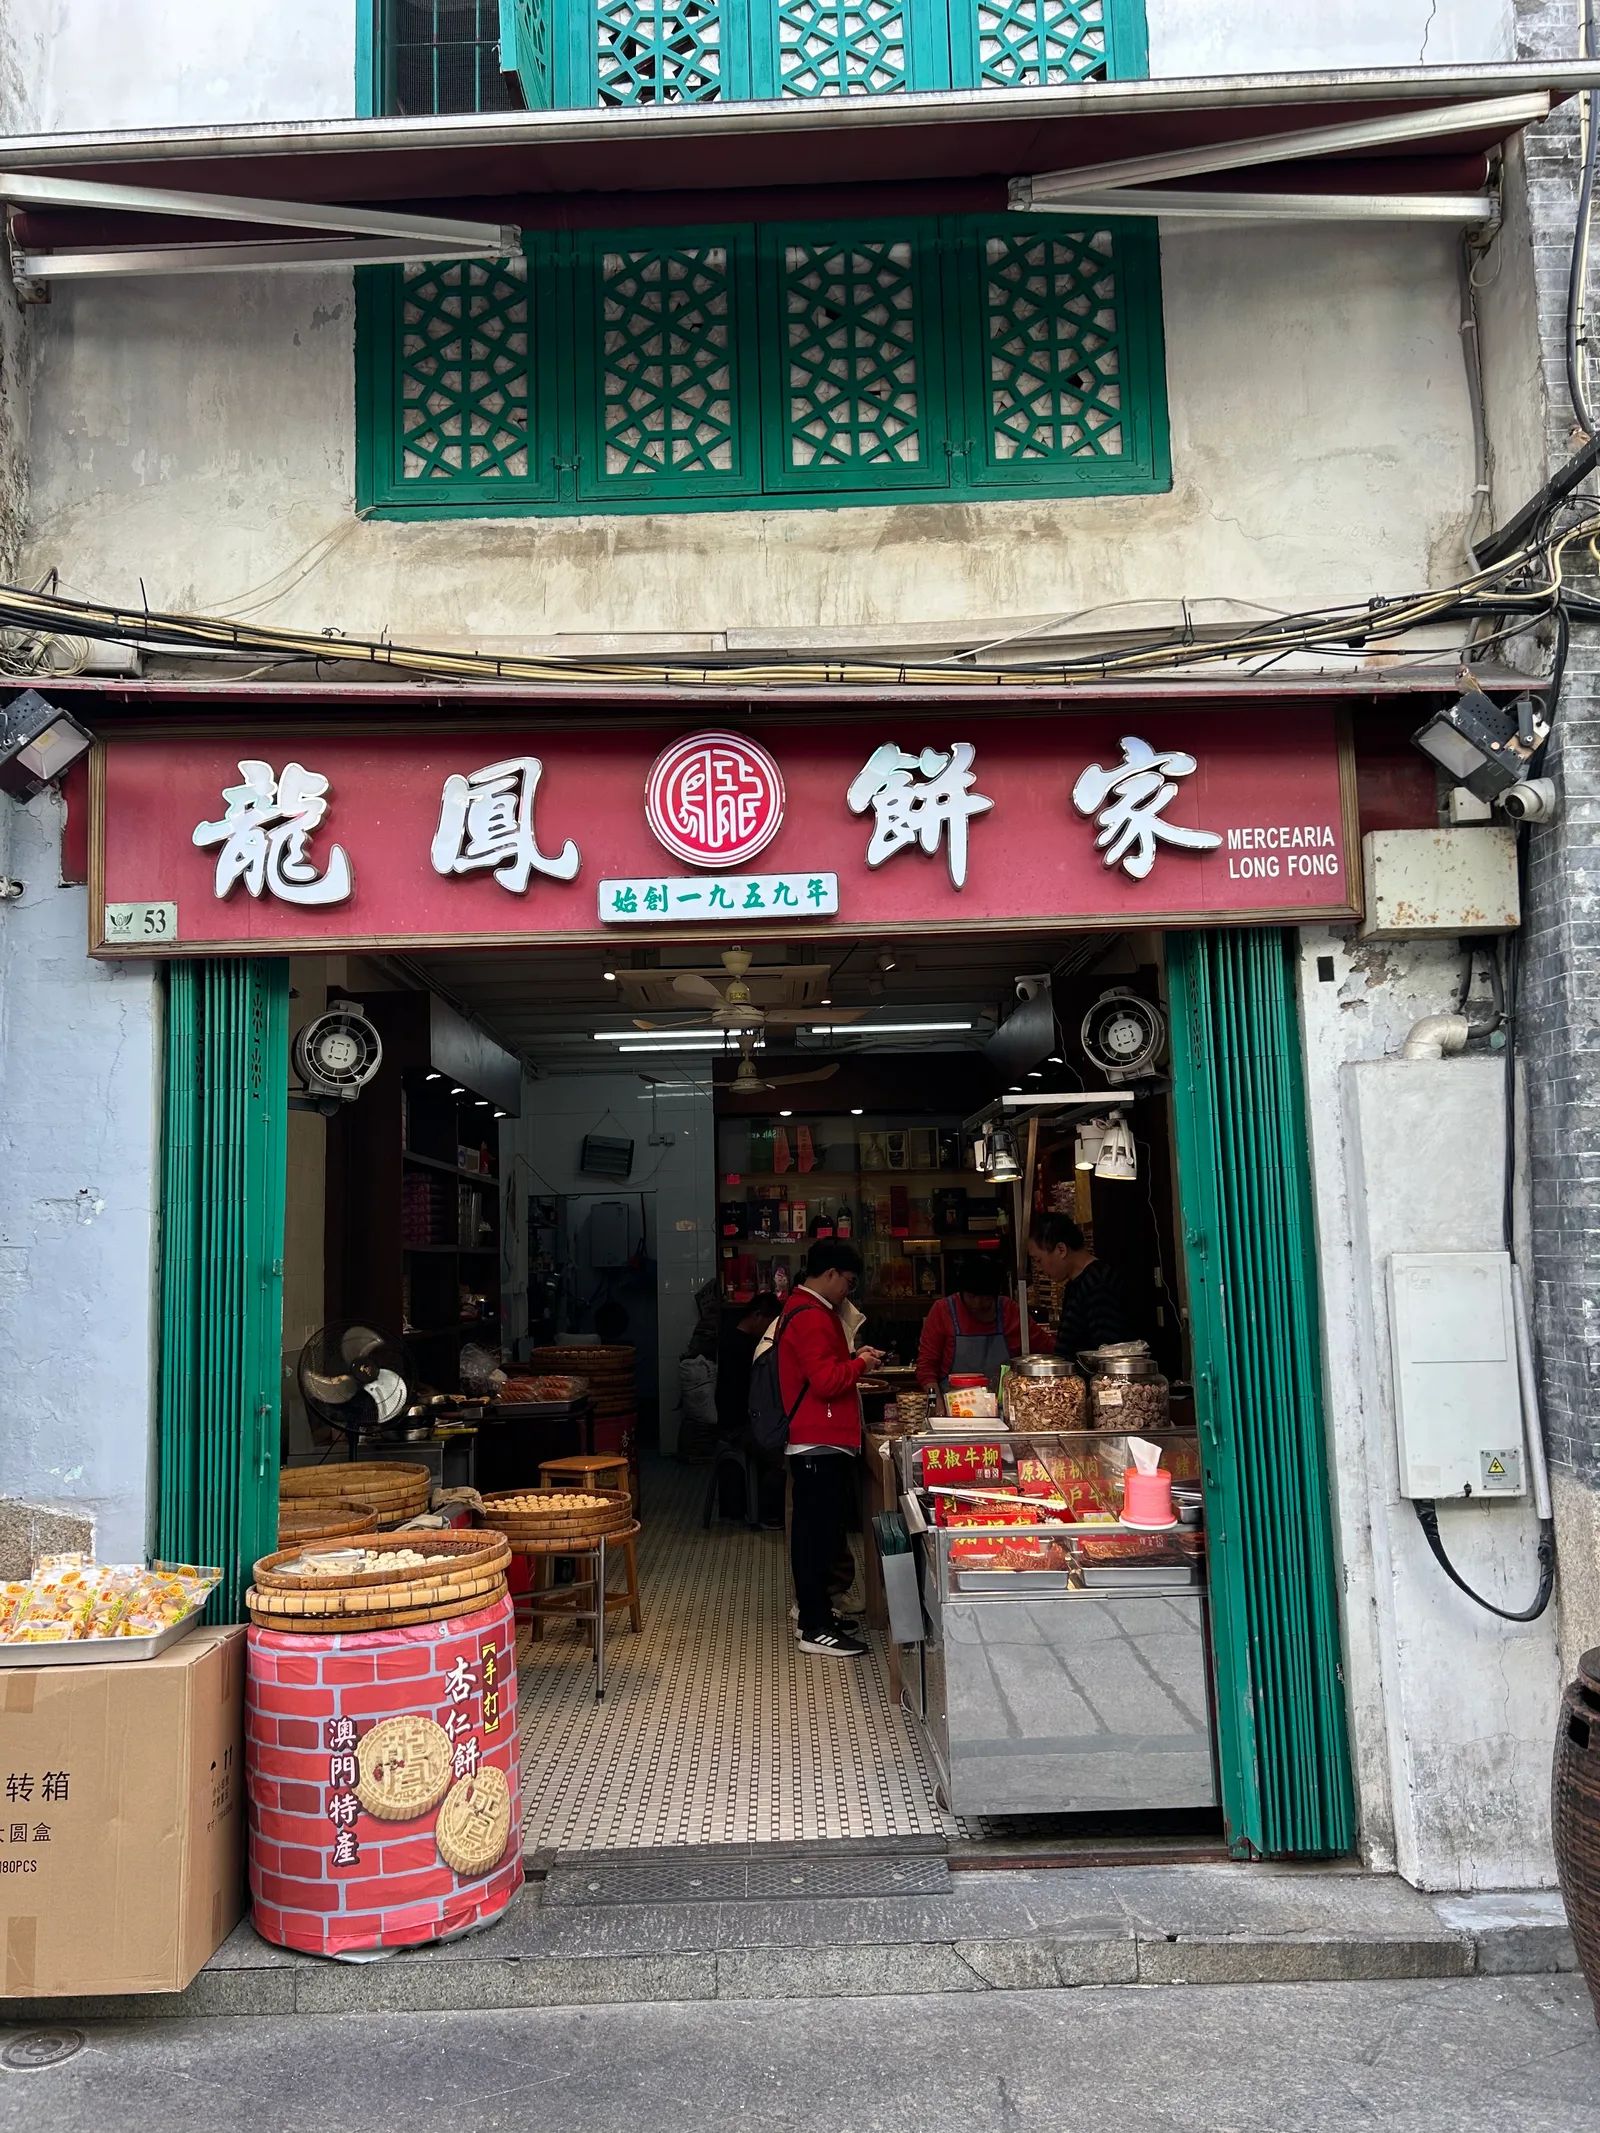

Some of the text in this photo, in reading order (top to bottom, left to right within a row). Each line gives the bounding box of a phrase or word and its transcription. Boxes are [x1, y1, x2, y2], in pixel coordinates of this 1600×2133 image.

[192, 734, 1223, 905] 龍鳳餅家
[1227, 825, 1336, 850] MERCEARIA
[1229, 853, 1339, 879] LONG FONG
[611, 878, 829, 913] 始創一九五九年
[144, 909, 167, 934] 53
[926, 1446, 999, 1470] 黑椒牛柳
[444, 1656, 481, 1779] 杏仁餅
[5, 1771, 71, 1803] 转箱
[329, 1719, 358, 1864] 澳門特產
[0, 1822, 52, 1843] 圆盒
[0, 1859, 37, 1873] 80PCS
